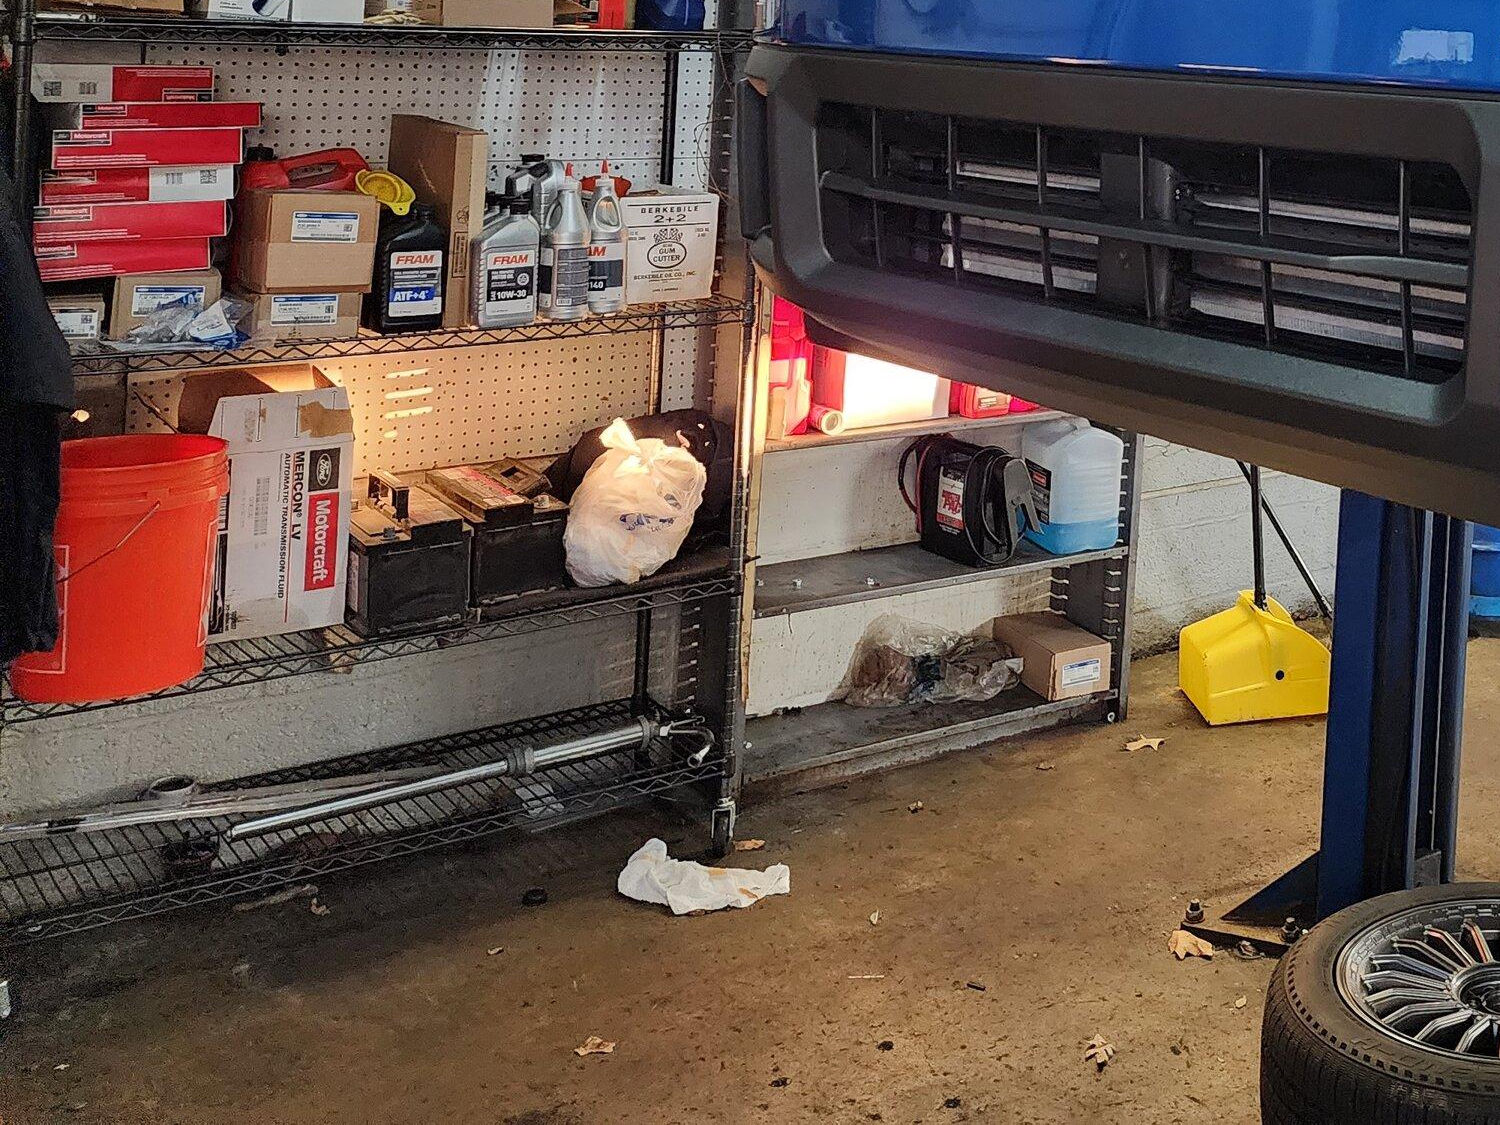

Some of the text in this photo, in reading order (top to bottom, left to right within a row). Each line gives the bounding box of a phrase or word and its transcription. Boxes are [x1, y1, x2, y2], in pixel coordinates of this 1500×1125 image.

[640, 205, 699, 214] BERKEBILE
[653, 213, 687, 223] 2+2
[586, 246, 607, 256] AM
[658, 247, 676, 255] GUM
[395, 254, 435, 265] FRAM
[492, 254, 529, 265] FRAM
[652, 255, 681, 263] CUTTER
[496, 289, 527, 300] 10W-30
[277, 453, 291, 599] AUTOMATIC TRANSMISSION FLUID
[291, 523, 301, 540] LV
[312, 499, 331, 584] Motorcraft
